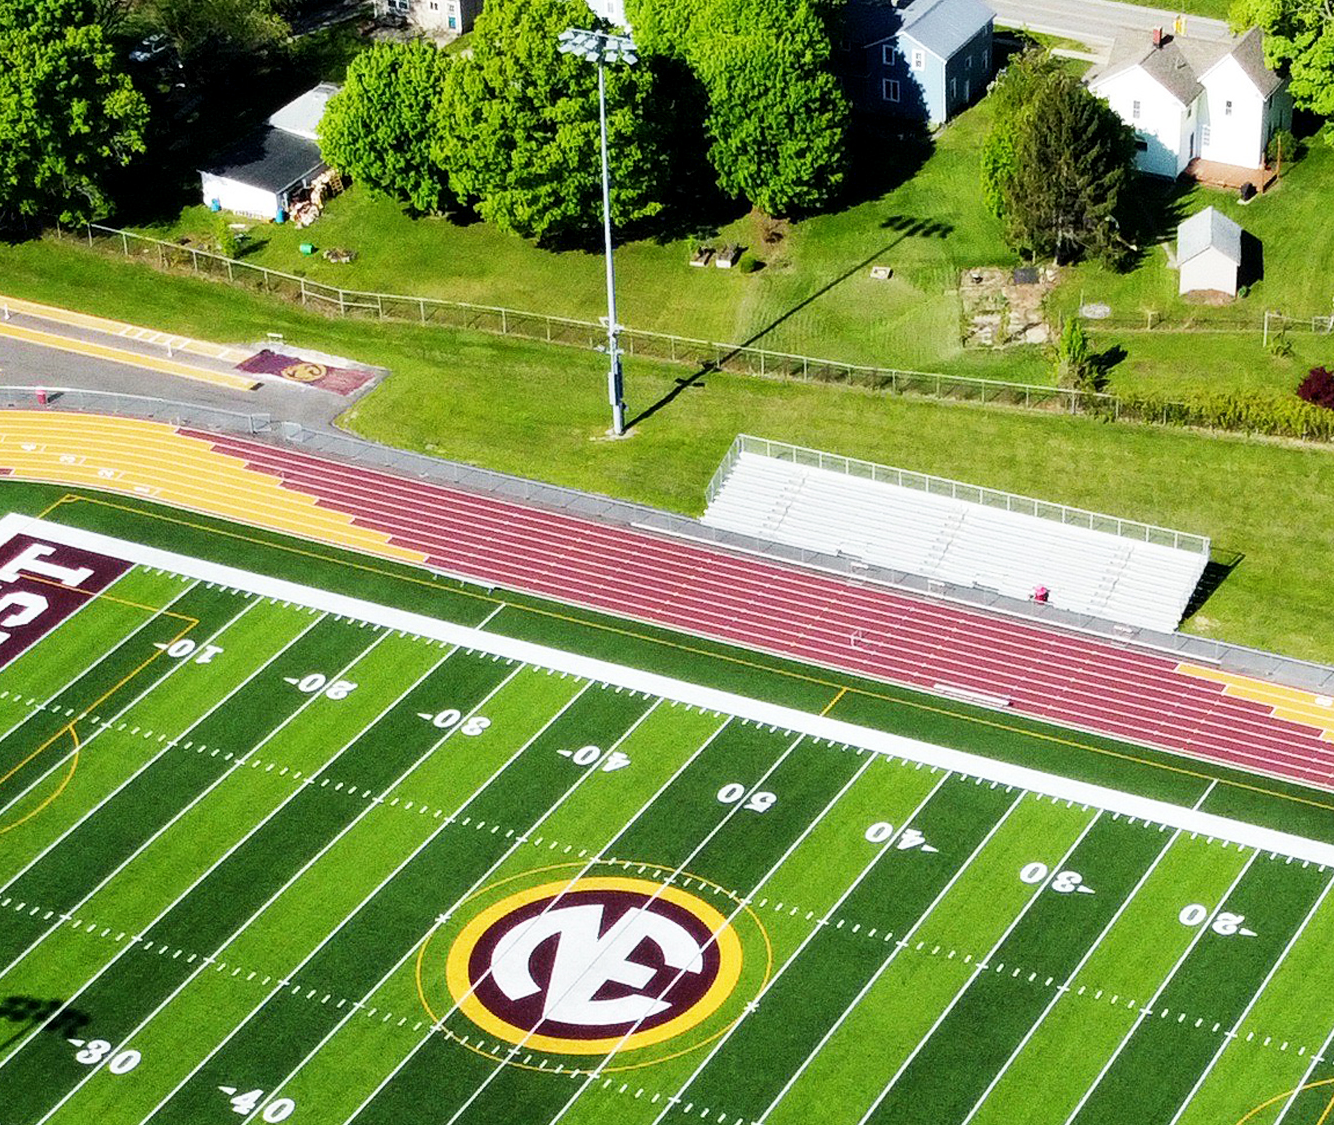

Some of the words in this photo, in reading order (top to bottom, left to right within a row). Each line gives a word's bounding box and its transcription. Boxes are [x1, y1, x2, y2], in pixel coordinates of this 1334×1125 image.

[167, 638, 224, 664] 10
[301, 673, 359, 700] 20
[432, 708, 491, 737] 30
[572, 745, 631, 774] 40
[717, 783, 777, 813] 50
[865, 821, 927, 852] 40
[1020, 862, 1083, 893] 30
[1178, 904, 1244, 936] 20
[75, 1040, 142, 1074] 30
[229, 1089, 295, 1124] 40
